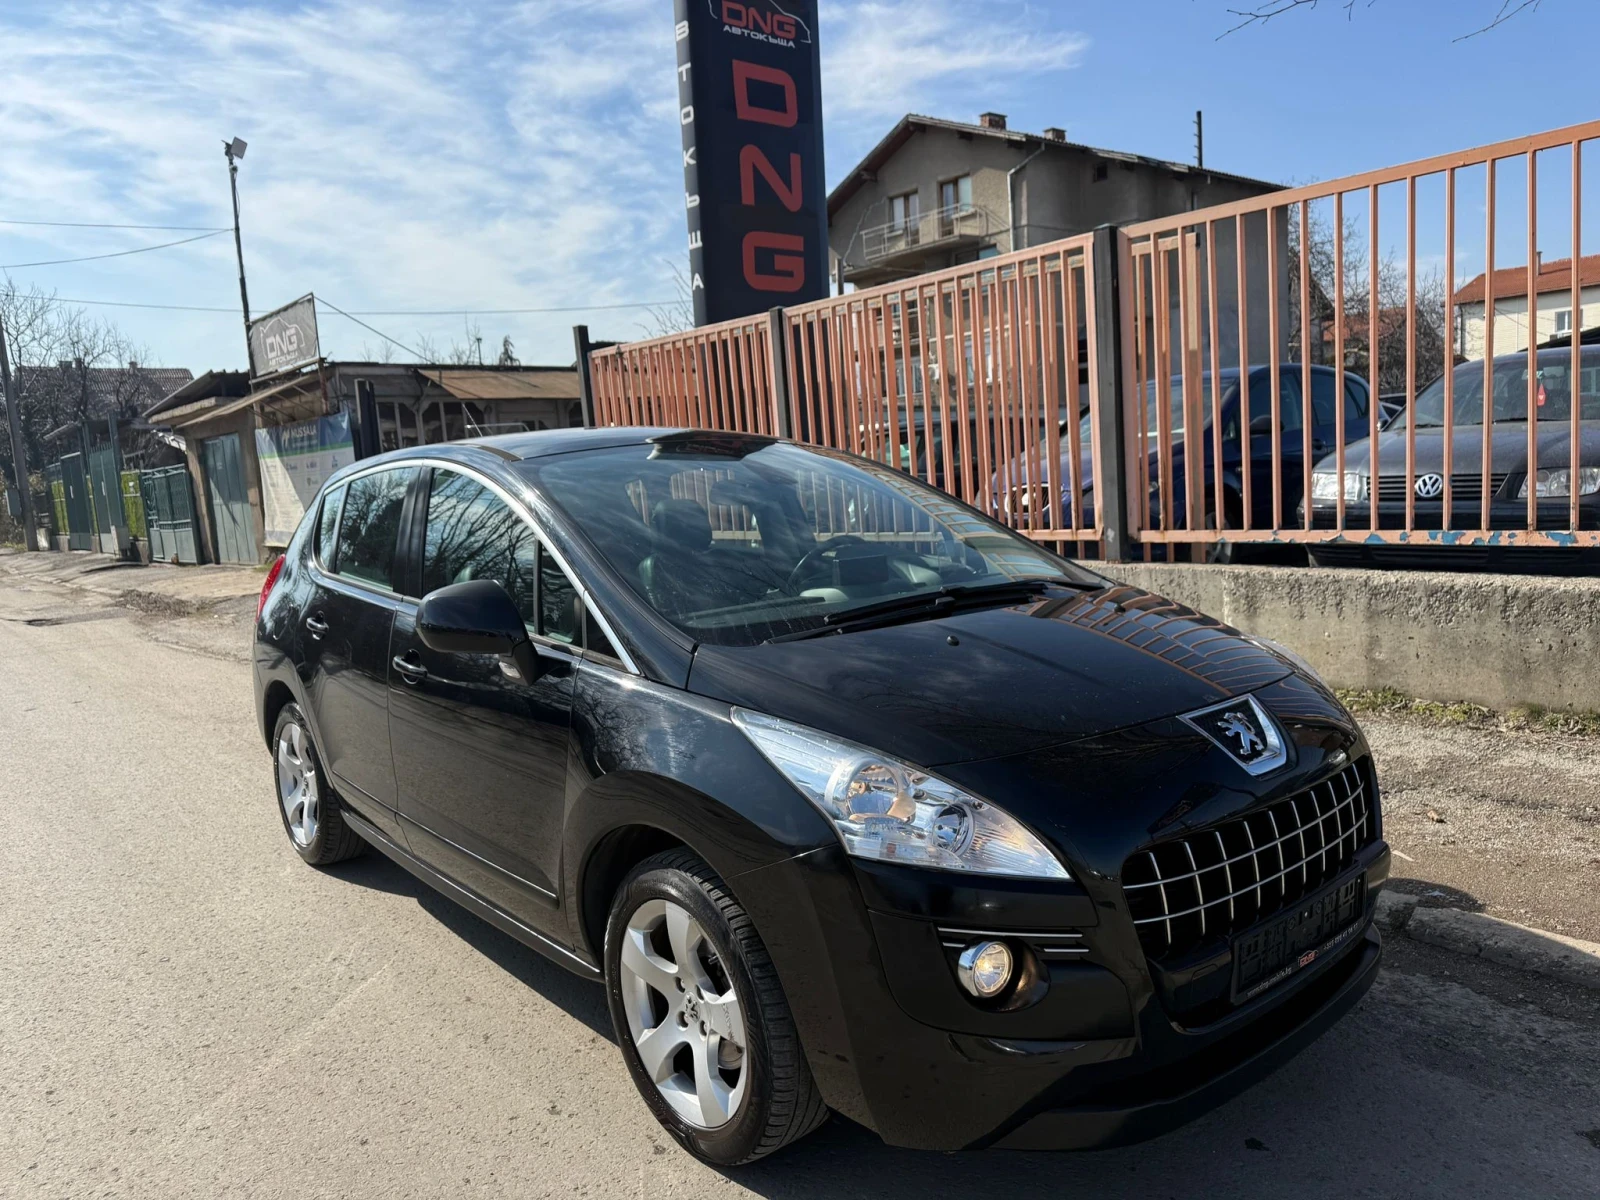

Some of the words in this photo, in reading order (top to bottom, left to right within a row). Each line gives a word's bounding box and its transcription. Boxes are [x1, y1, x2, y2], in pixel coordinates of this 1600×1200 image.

[721, 0, 796, 40] DNG
[732, 58, 805, 292] DNG
[265, 327, 298, 359] DNG
